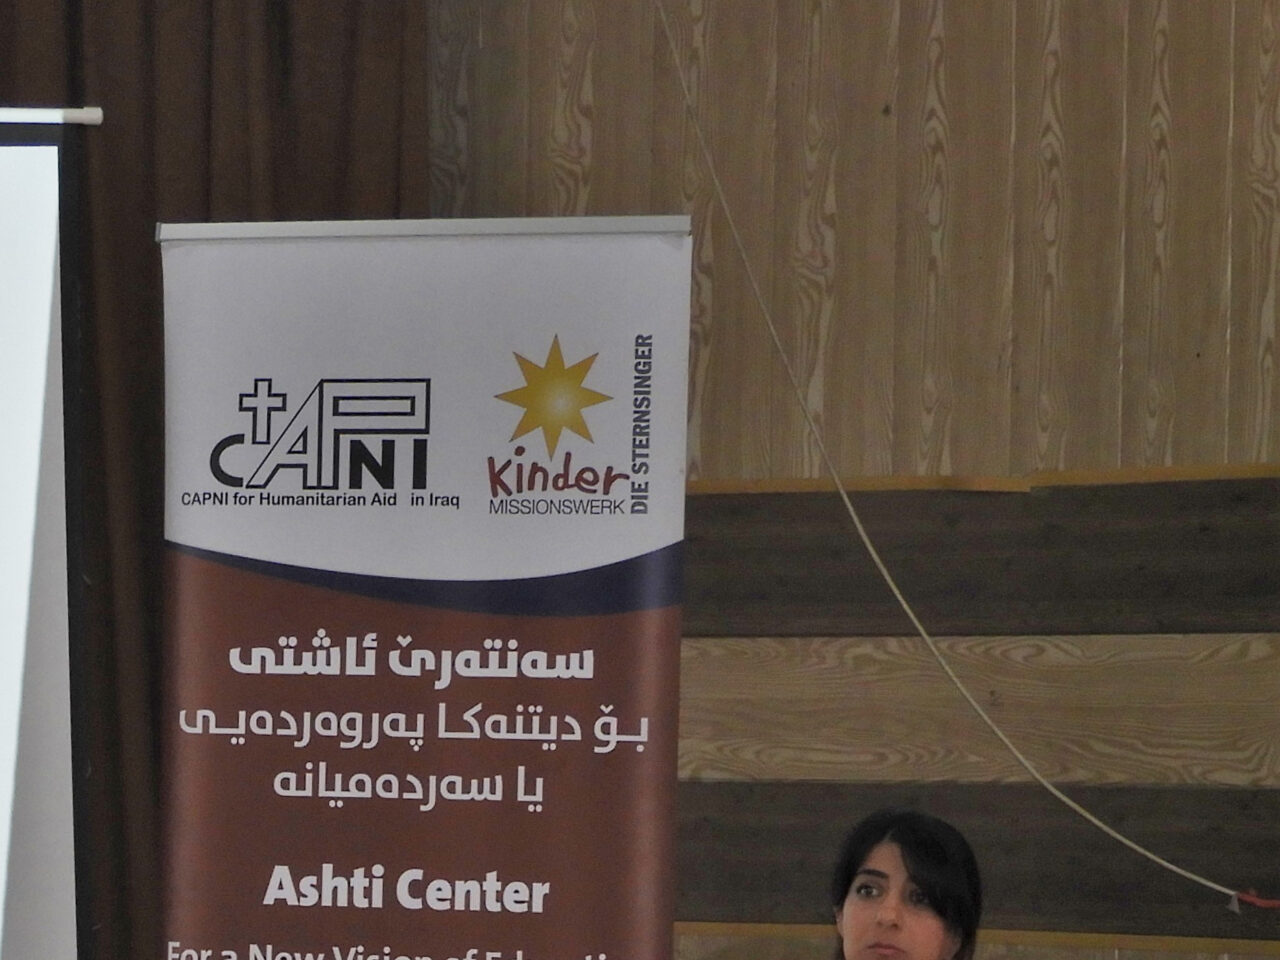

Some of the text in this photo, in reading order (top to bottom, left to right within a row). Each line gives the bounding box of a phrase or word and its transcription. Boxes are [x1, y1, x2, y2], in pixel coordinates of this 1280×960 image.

[209, 378, 431, 490] CAPNI
[630, 334, 653, 514] DIE STERNSINGER
[181, 491, 460, 510] CAPNI for Humanitarian Aid in Iraq
[489, 498, 625, 515] MISSIONSWERK
[263, 863, 551, 914] Ashti Center
